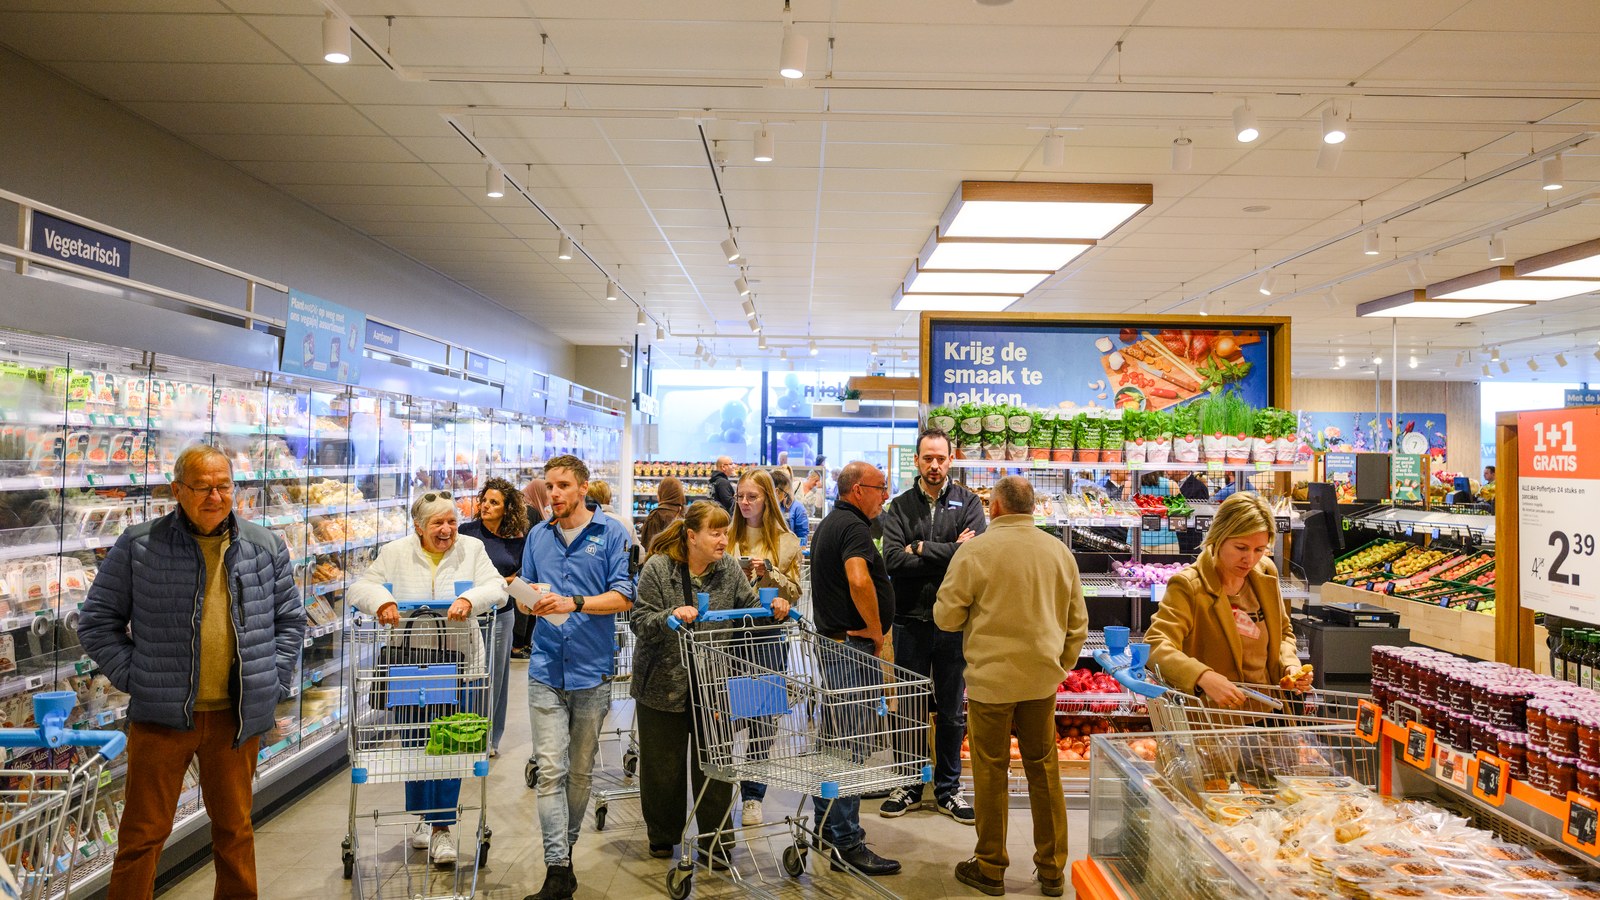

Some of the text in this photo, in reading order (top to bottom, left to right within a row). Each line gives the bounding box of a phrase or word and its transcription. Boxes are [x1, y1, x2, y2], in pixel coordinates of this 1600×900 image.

[44, 228, 120, 267] Vegetarisch
[944, 341, 1027, 365] Krijg de
[944, 365, 1043, 385] smaak te
[1585, 394, 1595, 402] de
[1533, 421, 1577, 452] 1+1
[1533, 455, 1577, 472] GRATIS
[1537, 485, 1556, 494] Poffertjes
[1564, 486, 1577, 494] stuks
